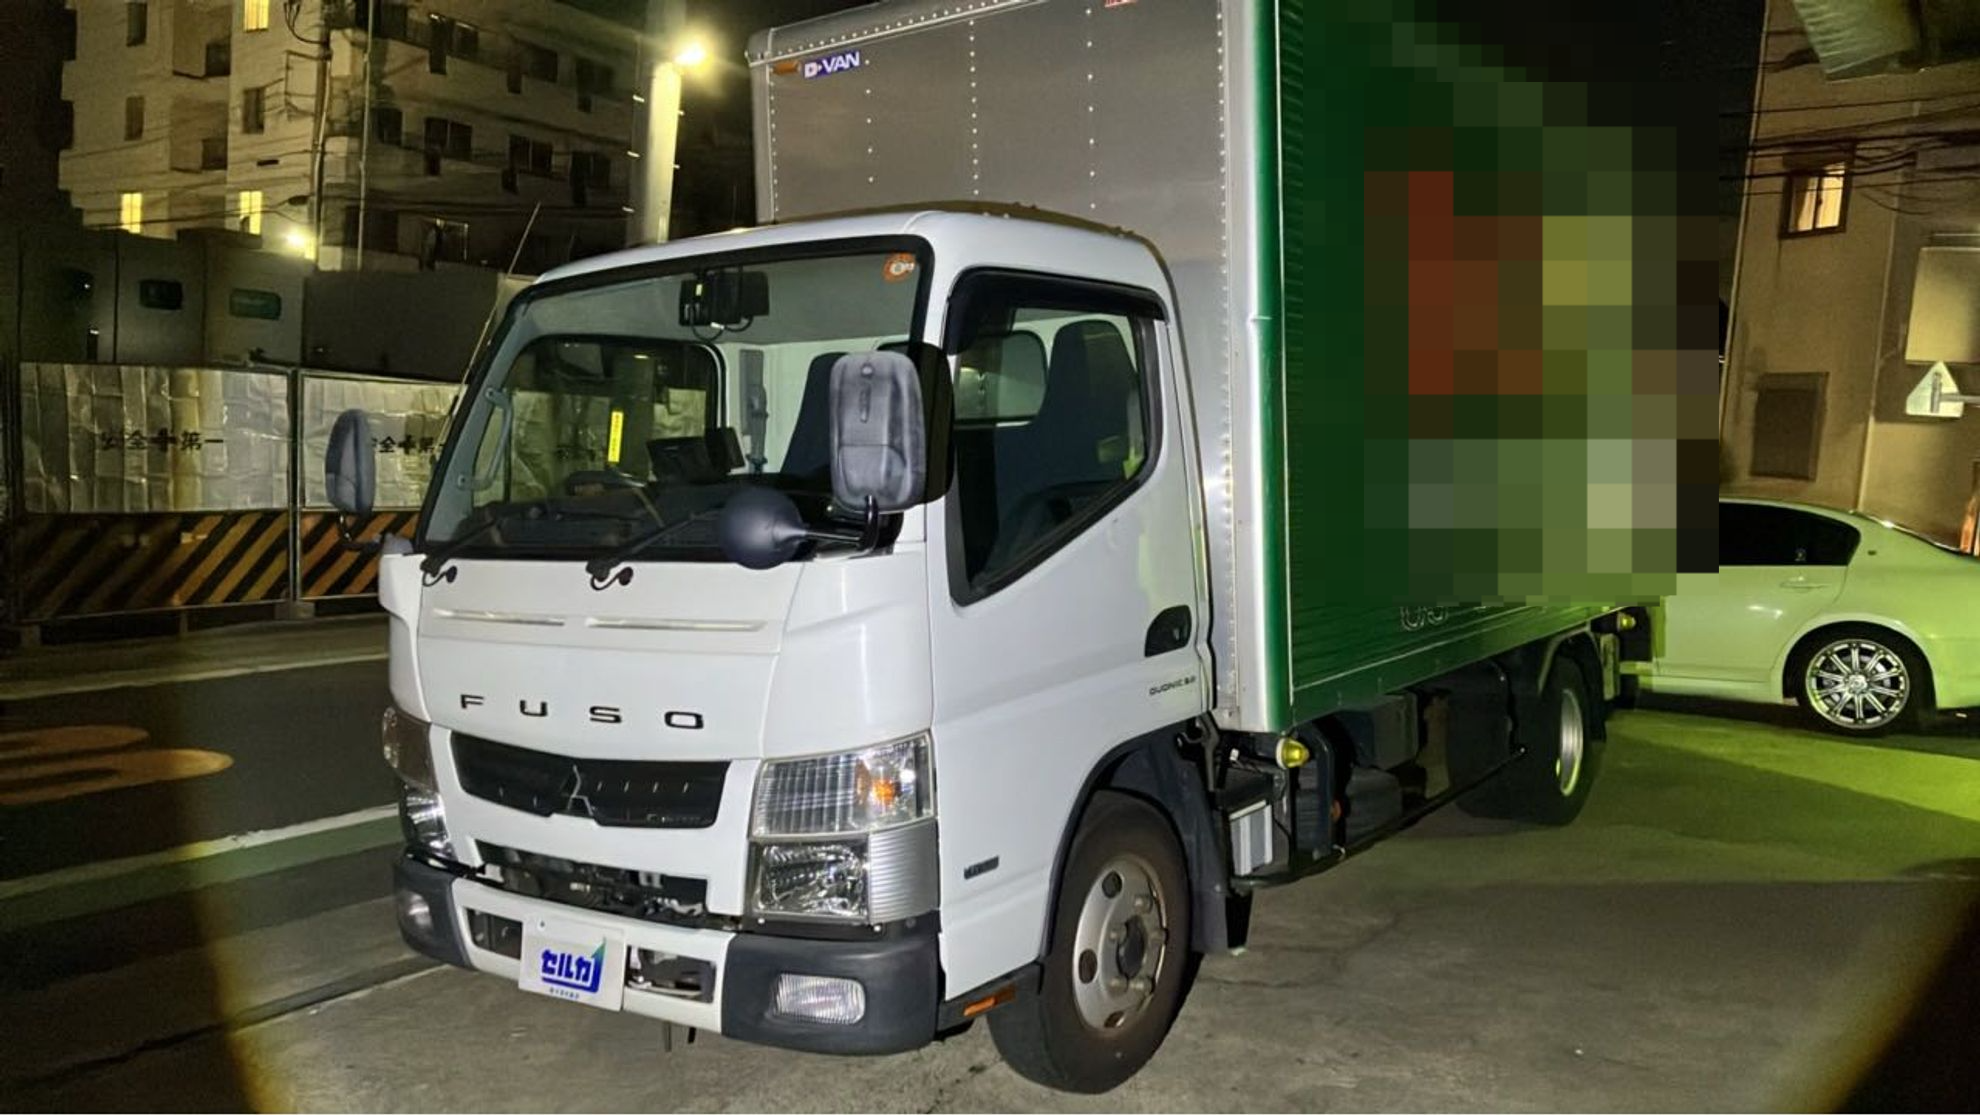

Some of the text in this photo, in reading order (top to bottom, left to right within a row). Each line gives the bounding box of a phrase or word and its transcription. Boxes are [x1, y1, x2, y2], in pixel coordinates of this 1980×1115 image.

[460, 693, 704, 730] FUSO
[541, 948, 593, 984] セルカ
